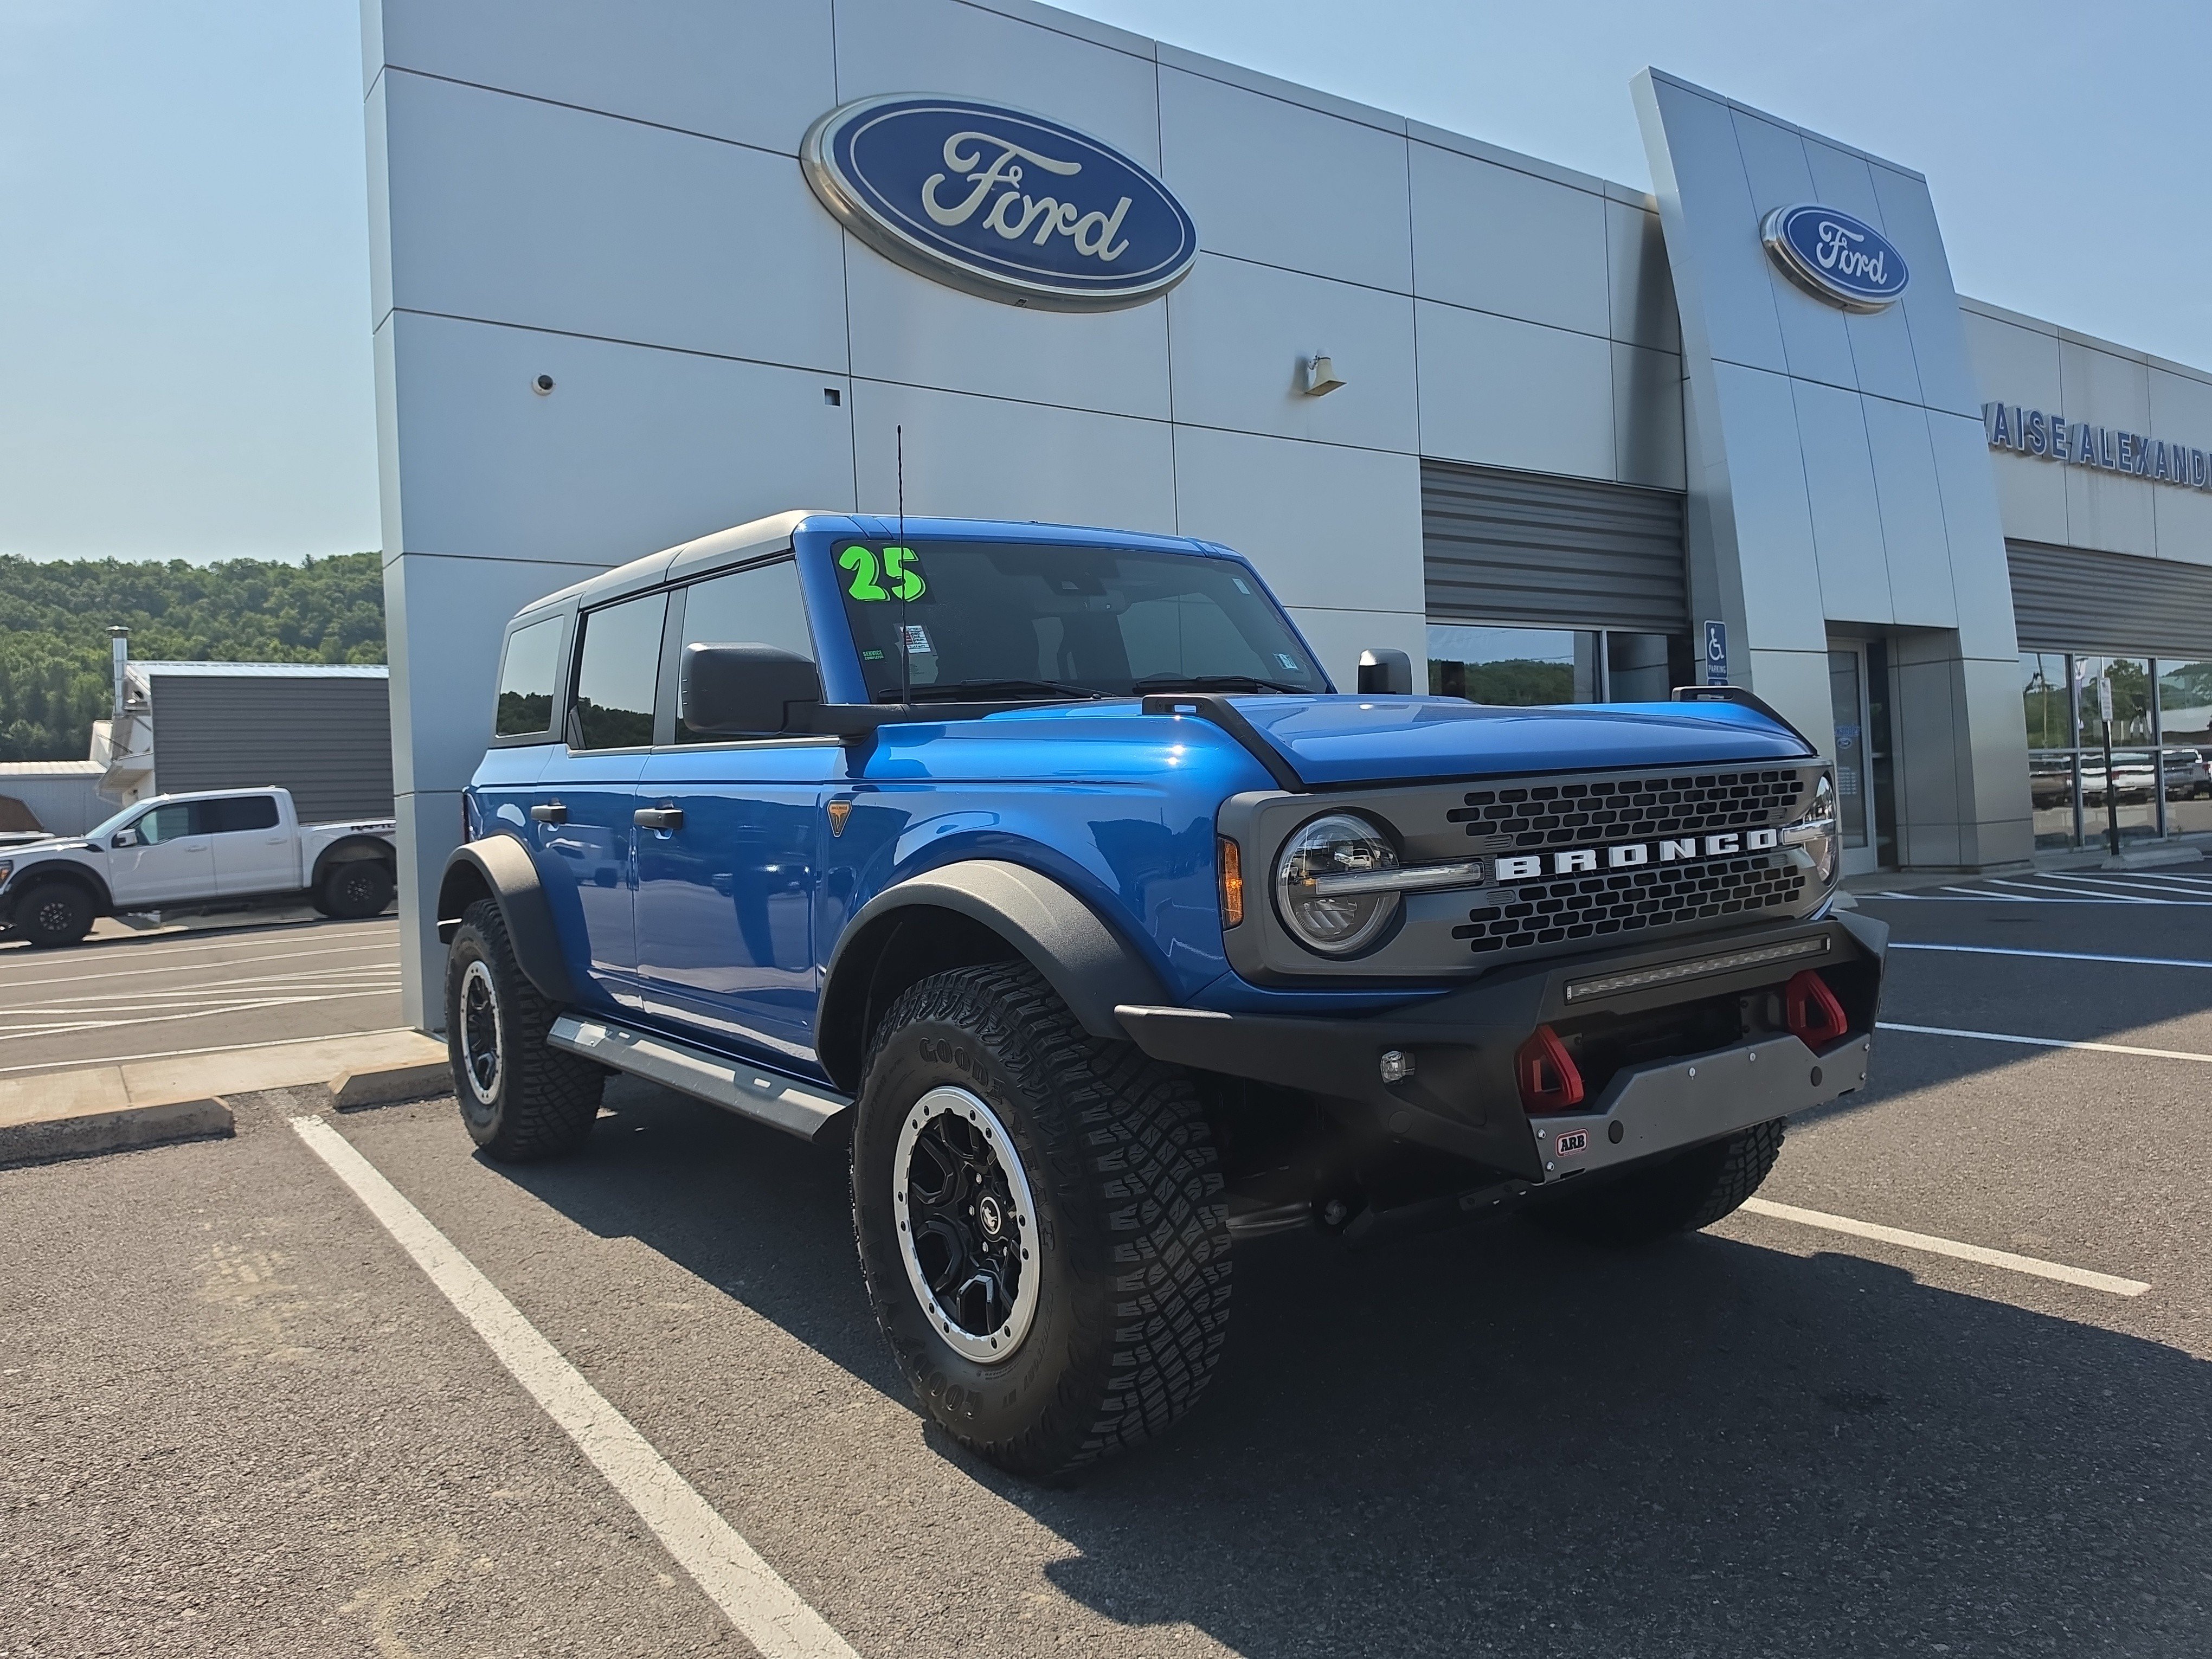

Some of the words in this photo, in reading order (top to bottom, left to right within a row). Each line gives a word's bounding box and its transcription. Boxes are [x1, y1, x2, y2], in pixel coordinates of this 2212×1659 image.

[922, 132, 1133, 262] Ford
[1816, 221, 1887, 285] Ford
[2079, 422, 2212, 489] ALEXAND
[838, 545, 926, 602] 25
[1708, 664, 1726, 674] PARKING
[1495, 828, 1777, 881] BRONCO
[1561, 1135, 1585, 1152] ARB
